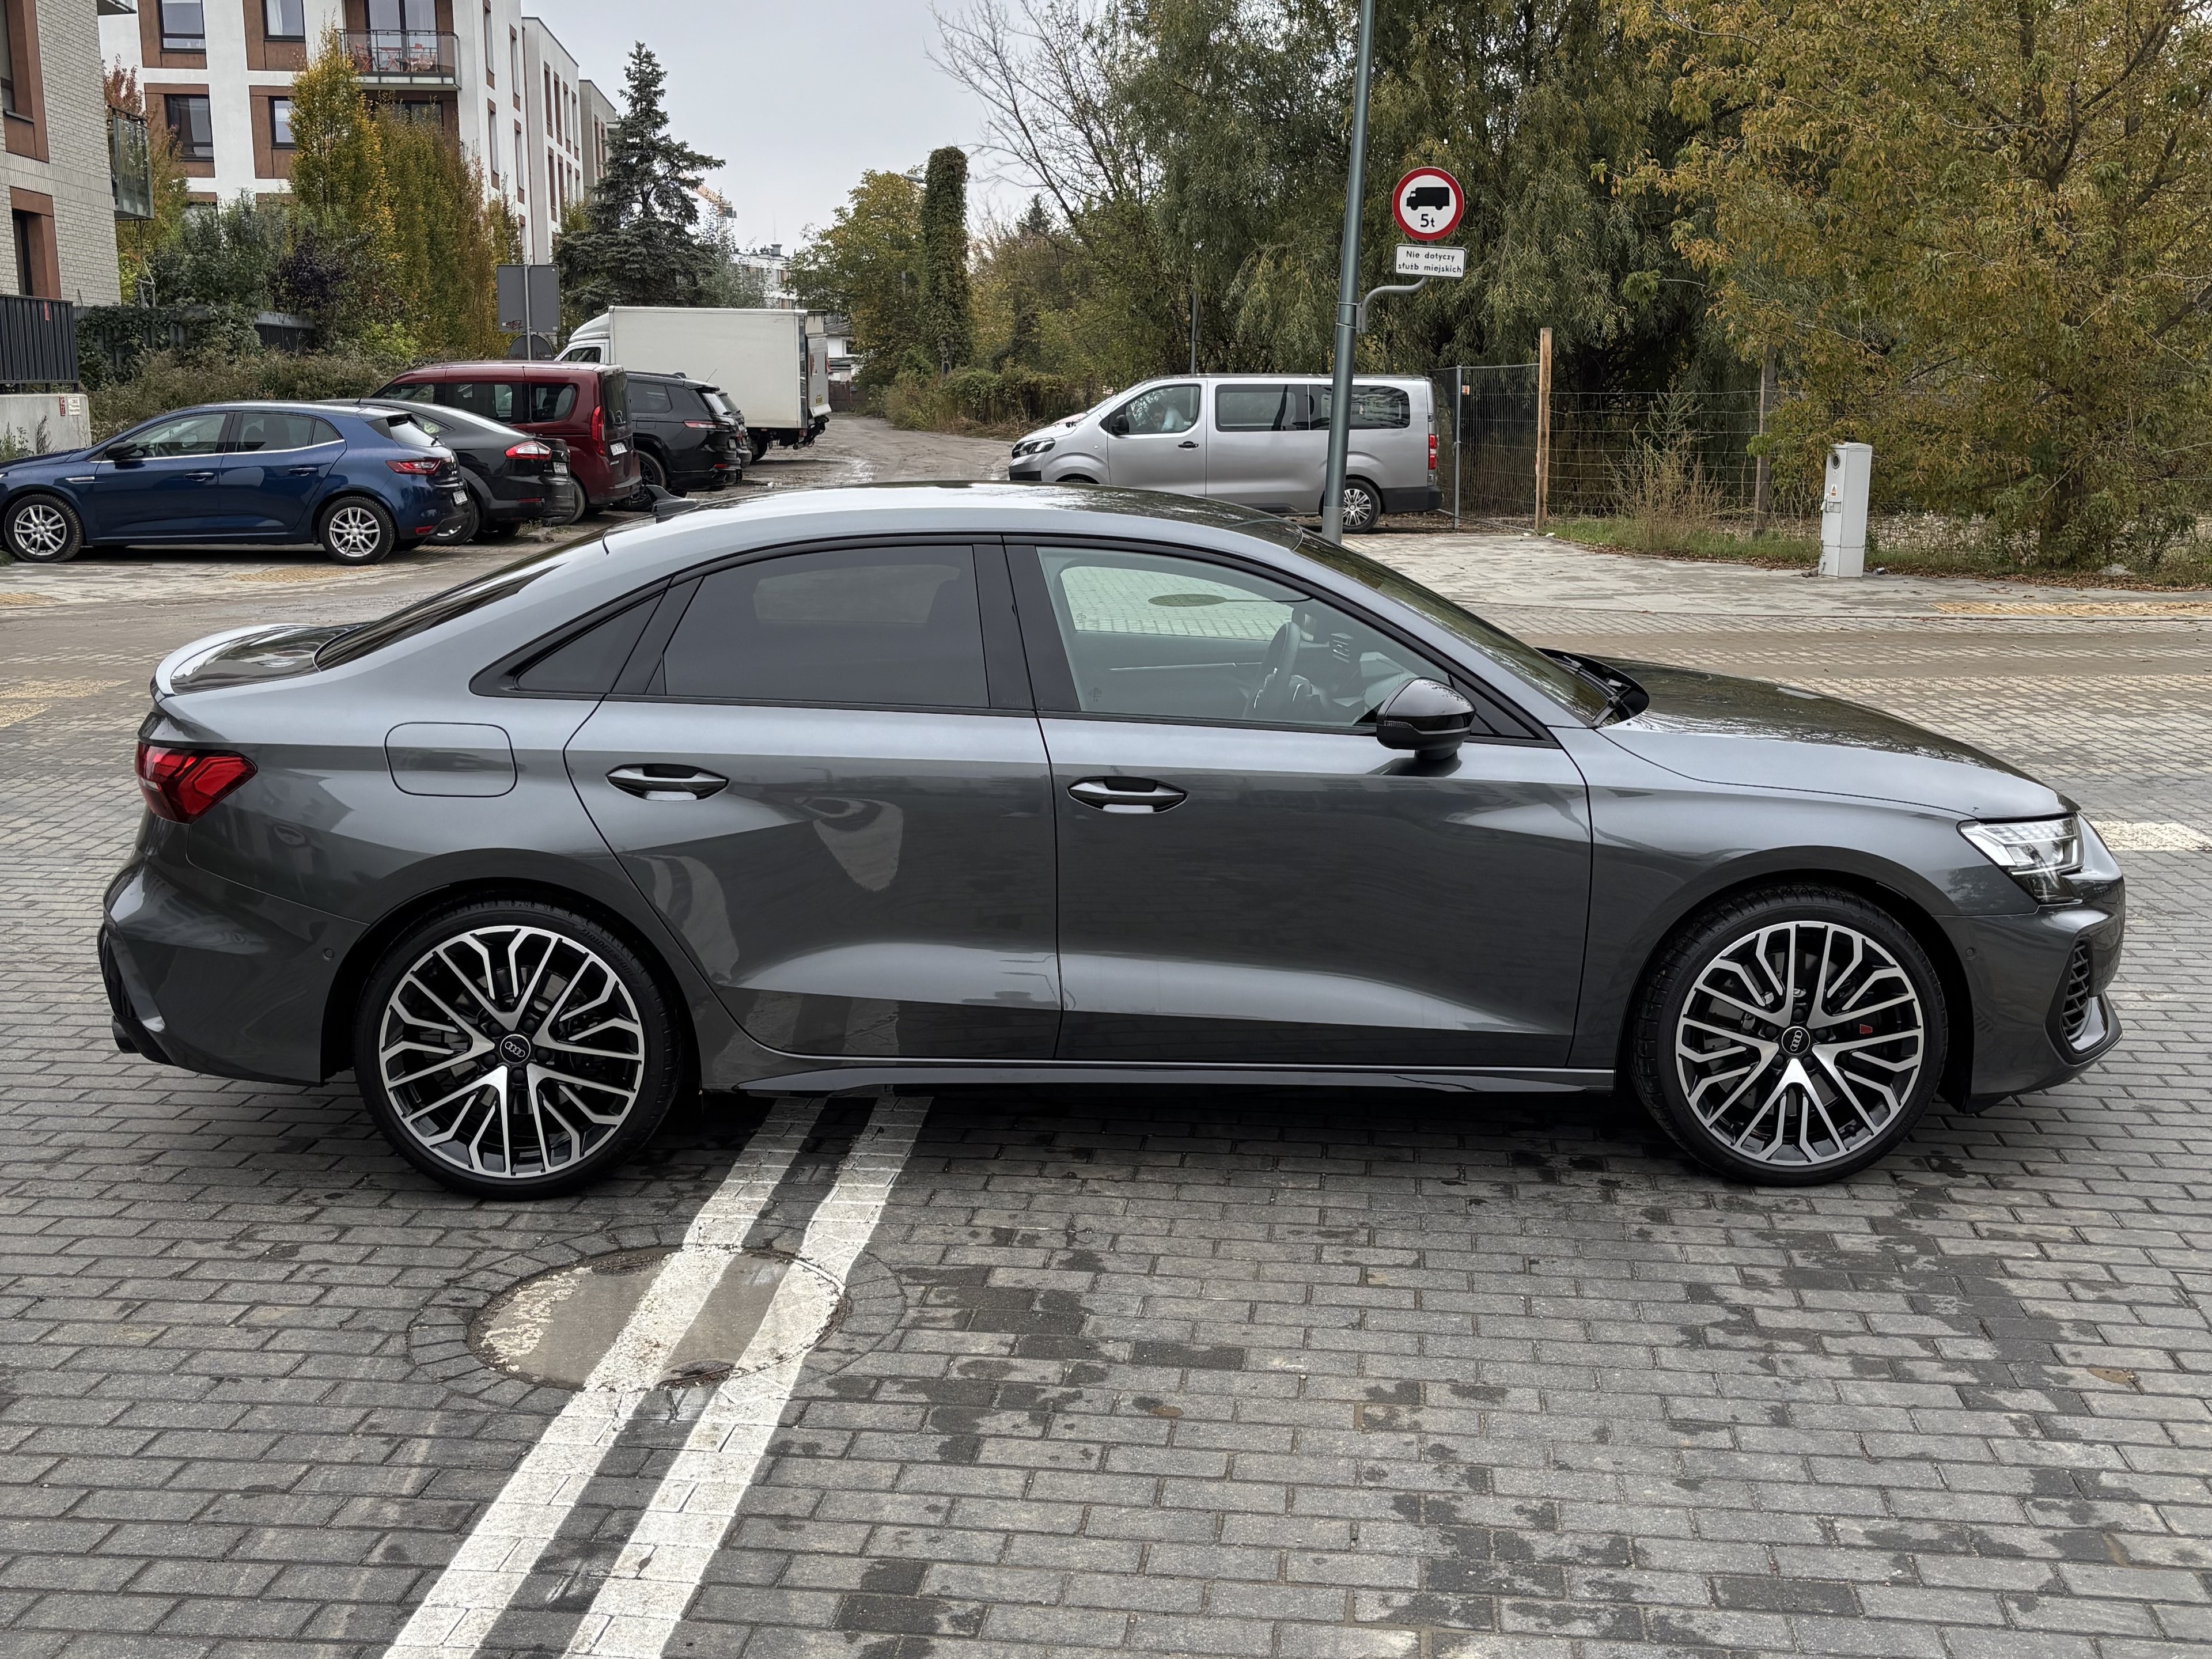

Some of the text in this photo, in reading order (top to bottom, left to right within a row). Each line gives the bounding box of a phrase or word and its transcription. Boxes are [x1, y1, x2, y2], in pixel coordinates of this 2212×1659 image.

[1425, 252, 1455, 262] dotyczy
[1424, 264, 1461, 274] miejskich
[579, 928, 635, 977] BRIDGESTONE
